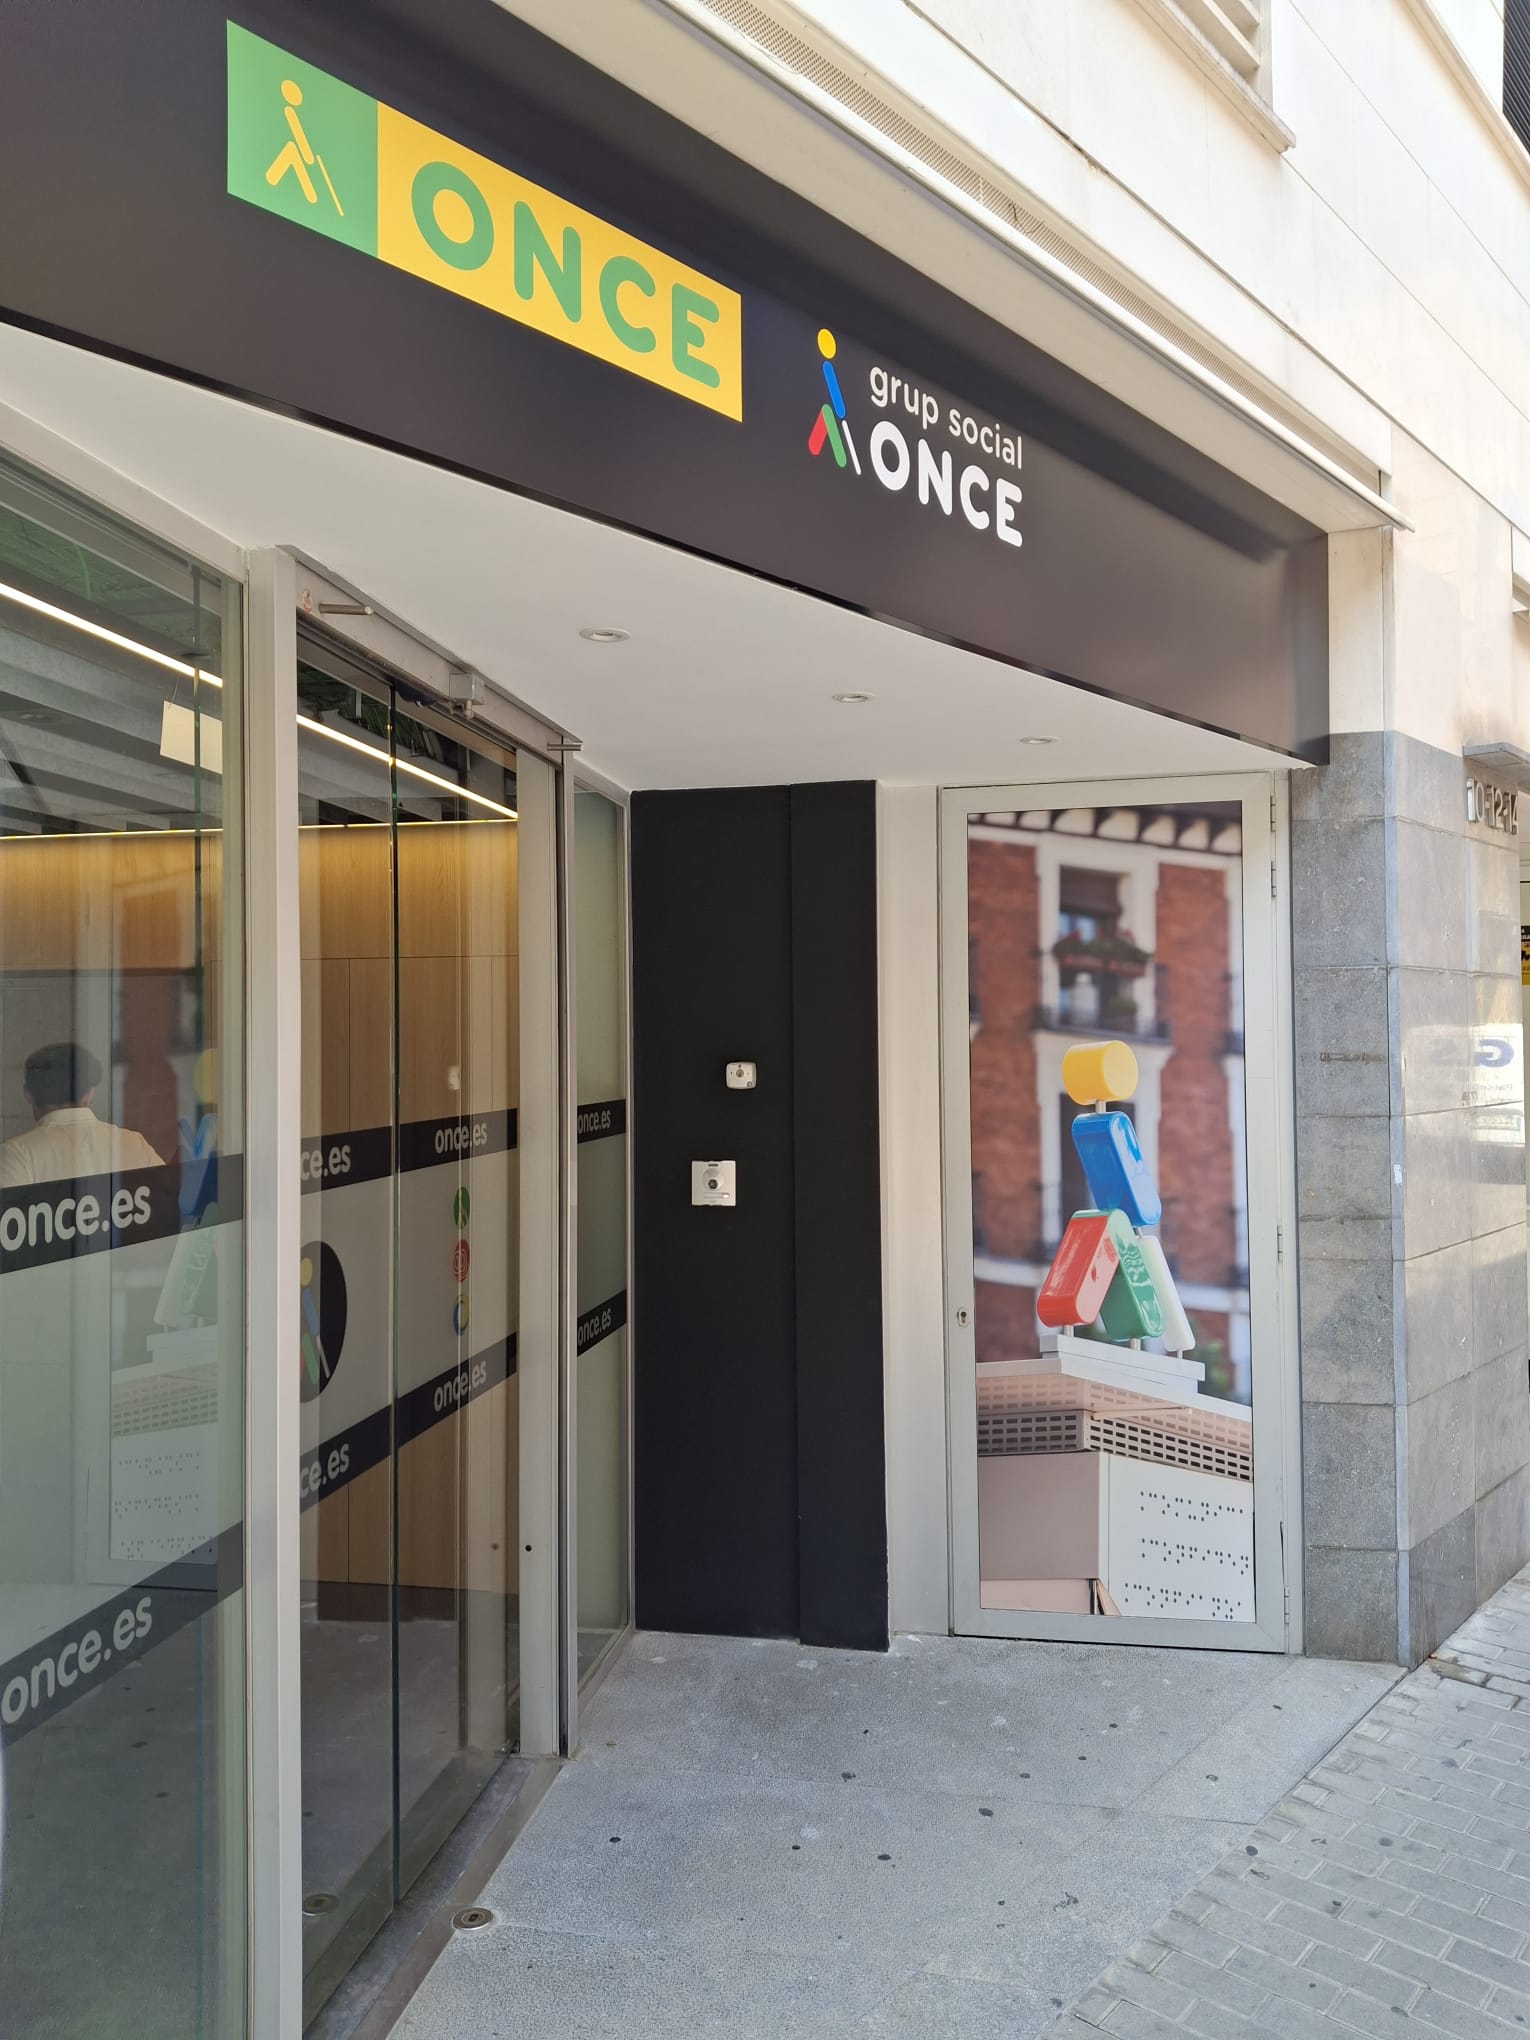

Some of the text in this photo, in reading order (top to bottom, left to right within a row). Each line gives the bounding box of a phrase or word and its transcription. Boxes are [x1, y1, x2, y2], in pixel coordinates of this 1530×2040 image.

[411, 161, 722, 389] ONCE
[870, 366, 1022, 469] grup social
[870, 420, 1023, 547] ONCE
[434, 1121, 488, 1155] once.es
[577, 1109, 612, 1134] once.es
[0, 1185, 151, 1251] once.es
[577, 1307, 612, 1347] once.es
[433, 1360, 487, 1412] once.es
[1, 1596, 153, 1724] once.es
